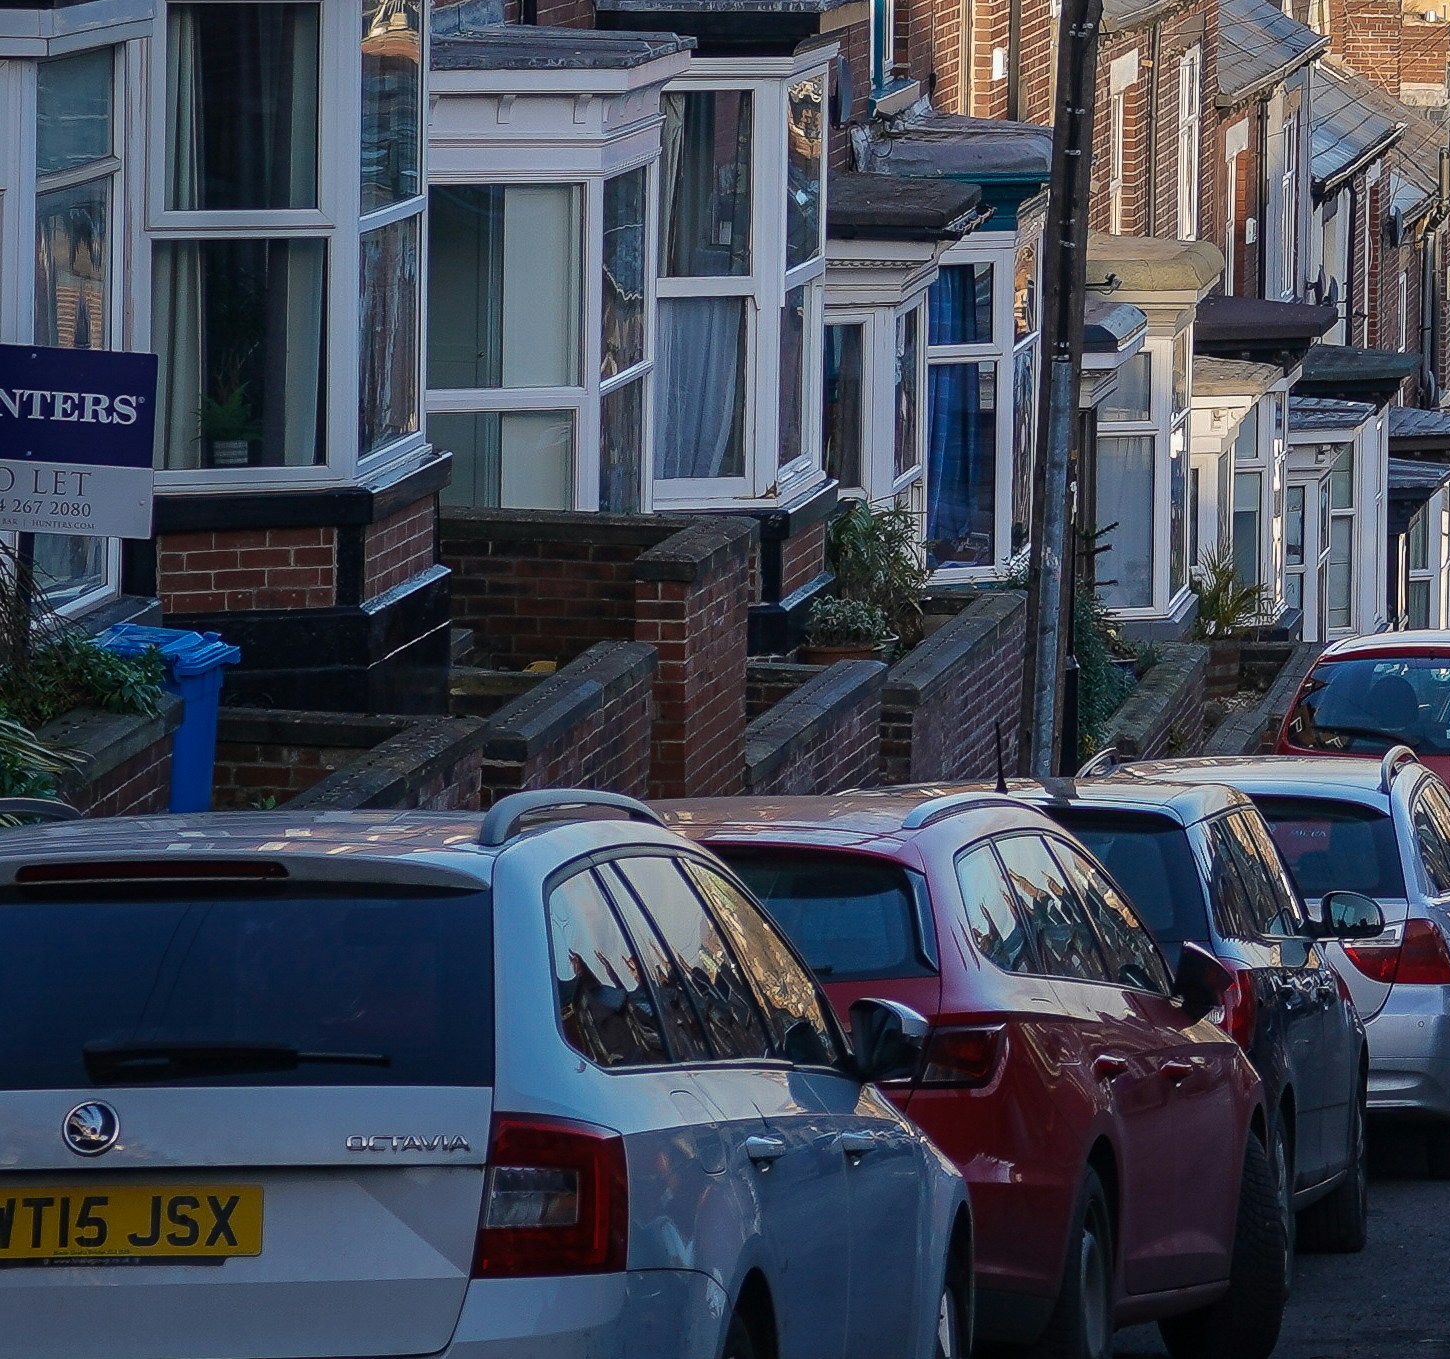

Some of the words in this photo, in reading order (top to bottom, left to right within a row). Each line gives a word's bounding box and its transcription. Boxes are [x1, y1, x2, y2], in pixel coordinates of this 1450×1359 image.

[32, 469, 92, 497] LET
[12, 499, 43, 515] 267
[49, 501, 91, 518] 2080
[346, 1135, 470, 1152] OCTAVIA
[127, 1195, 241, 1247] JSX
